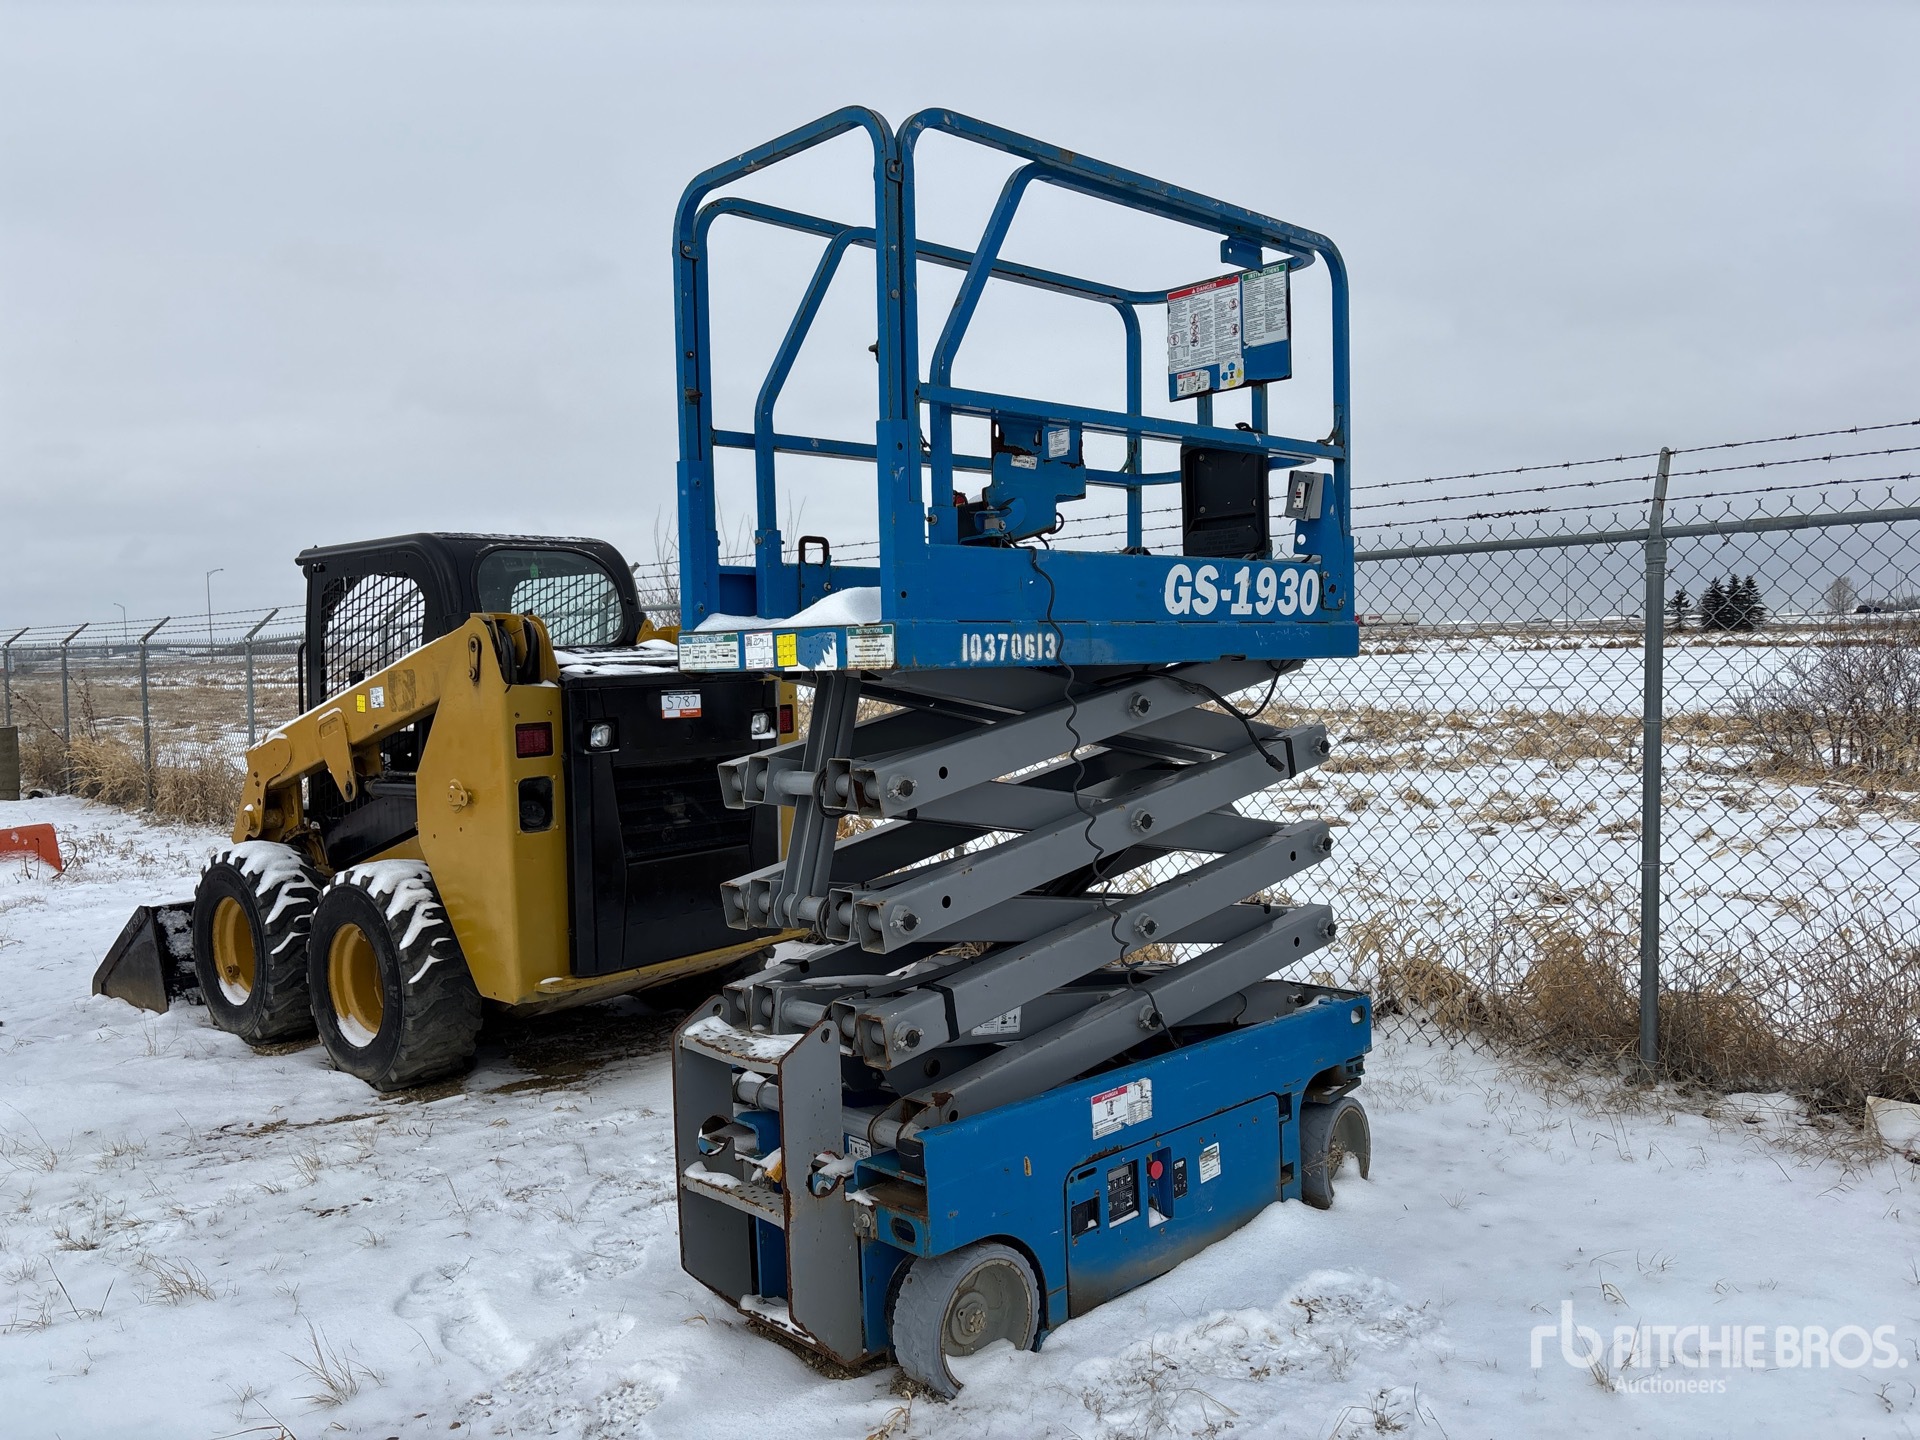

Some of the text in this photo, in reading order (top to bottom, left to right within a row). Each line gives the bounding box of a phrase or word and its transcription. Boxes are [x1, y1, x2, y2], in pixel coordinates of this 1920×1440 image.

[1164, 564, 1320, 616] GS-1930
[962, 633, 1056, 661] 10370613
[665, 695, 697, 710] 5787
